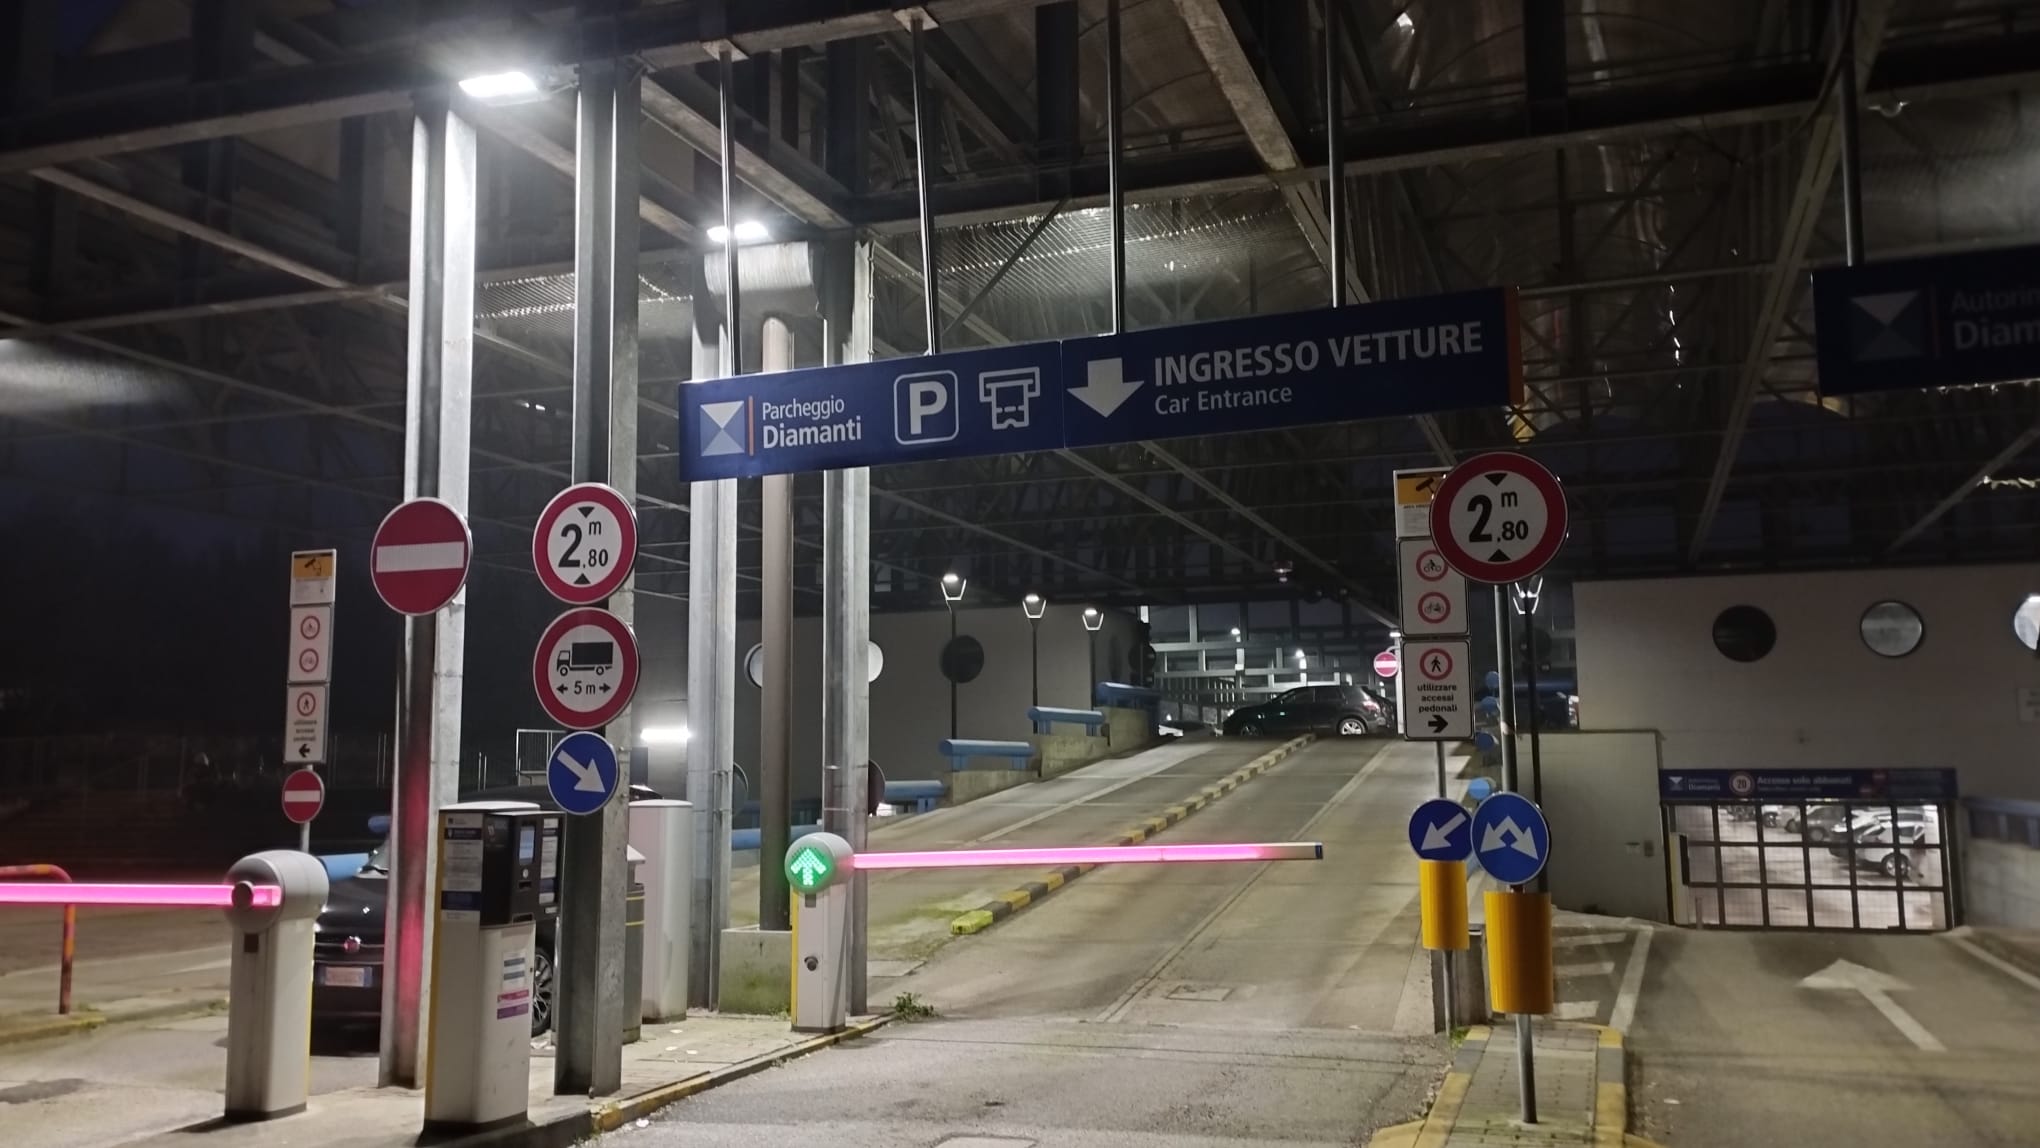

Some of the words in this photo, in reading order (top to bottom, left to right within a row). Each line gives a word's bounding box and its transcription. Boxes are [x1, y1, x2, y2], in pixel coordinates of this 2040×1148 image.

[1154, 340, 1320, 387] INGRESSO
[1327, 321, 1484, 368] VETTURE
[762, 394, 845, 421] Parcheggio
[908, 381, 948, 435] P
[1154, 394, 1190, 415] Car
[1197, 386, 1293, 412] Entrance
[762, 415, 863, 450] Diamanti
[1500, 491, 1518, 508] m
[588, 520, 602, 536] m
[574, 680, 583, 696] 5
[585, 683, 596, 696] m
[1417, 683, 1457, 691] utilizzare
[1421, 694, 1454, 702] accessi
[1418, 704, 1458, 713] pedonali
